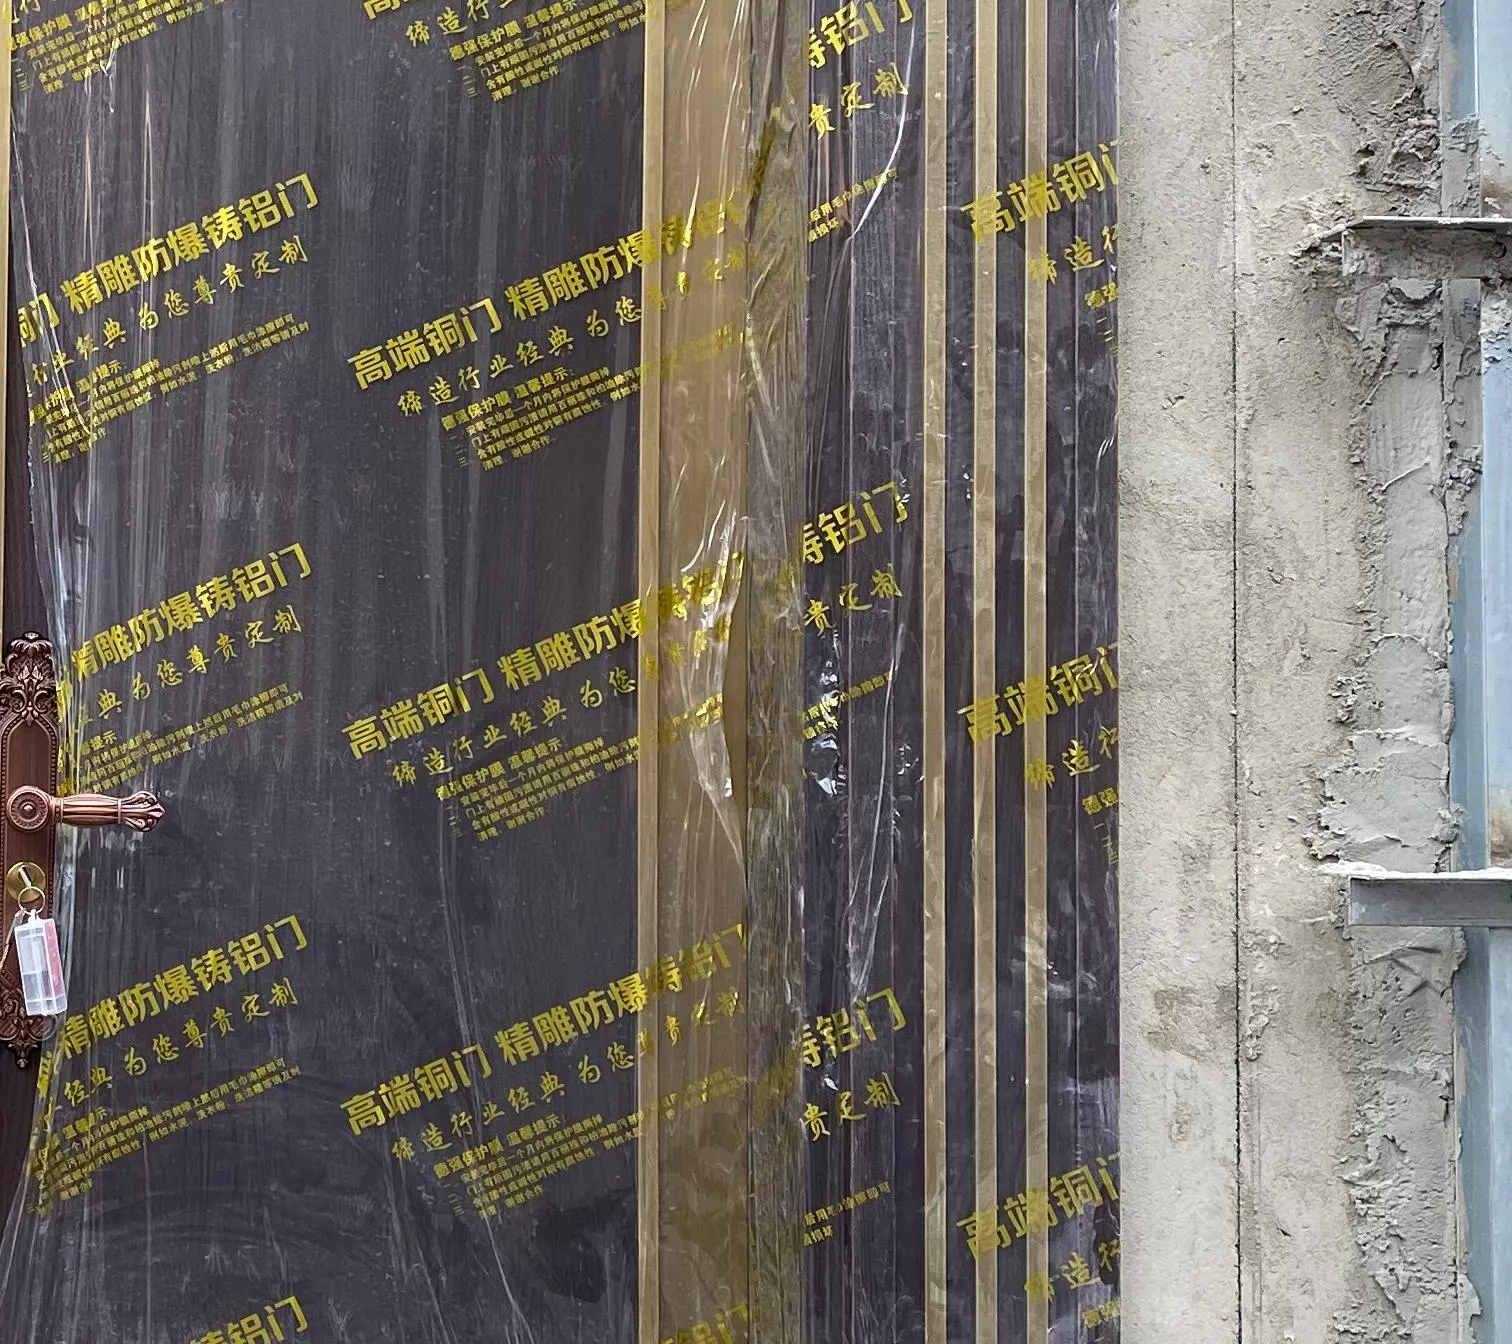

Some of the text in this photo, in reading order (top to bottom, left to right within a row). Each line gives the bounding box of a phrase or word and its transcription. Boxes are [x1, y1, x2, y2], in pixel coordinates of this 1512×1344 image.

[61, 172, 317, 315] 精雕防爆铸铝门
[137, 235, 307, 330] 为您尊贵定制
[347, 296, 503, 389] 高端铜门
[396, 325, 575, 418] 缔造行业经典
[132, 605, 300, 700] 为您尊贵定制
[340, 666, 497, 759] 高端铜门
[390, 696, 569, 788] 缔造行业经典
[126, 977, 297, 1076] 为您尊贵定制
[338, 1040, 495, 1135] 高端铜门
[389, 1071, 567, 1165] 缔造行业经典
